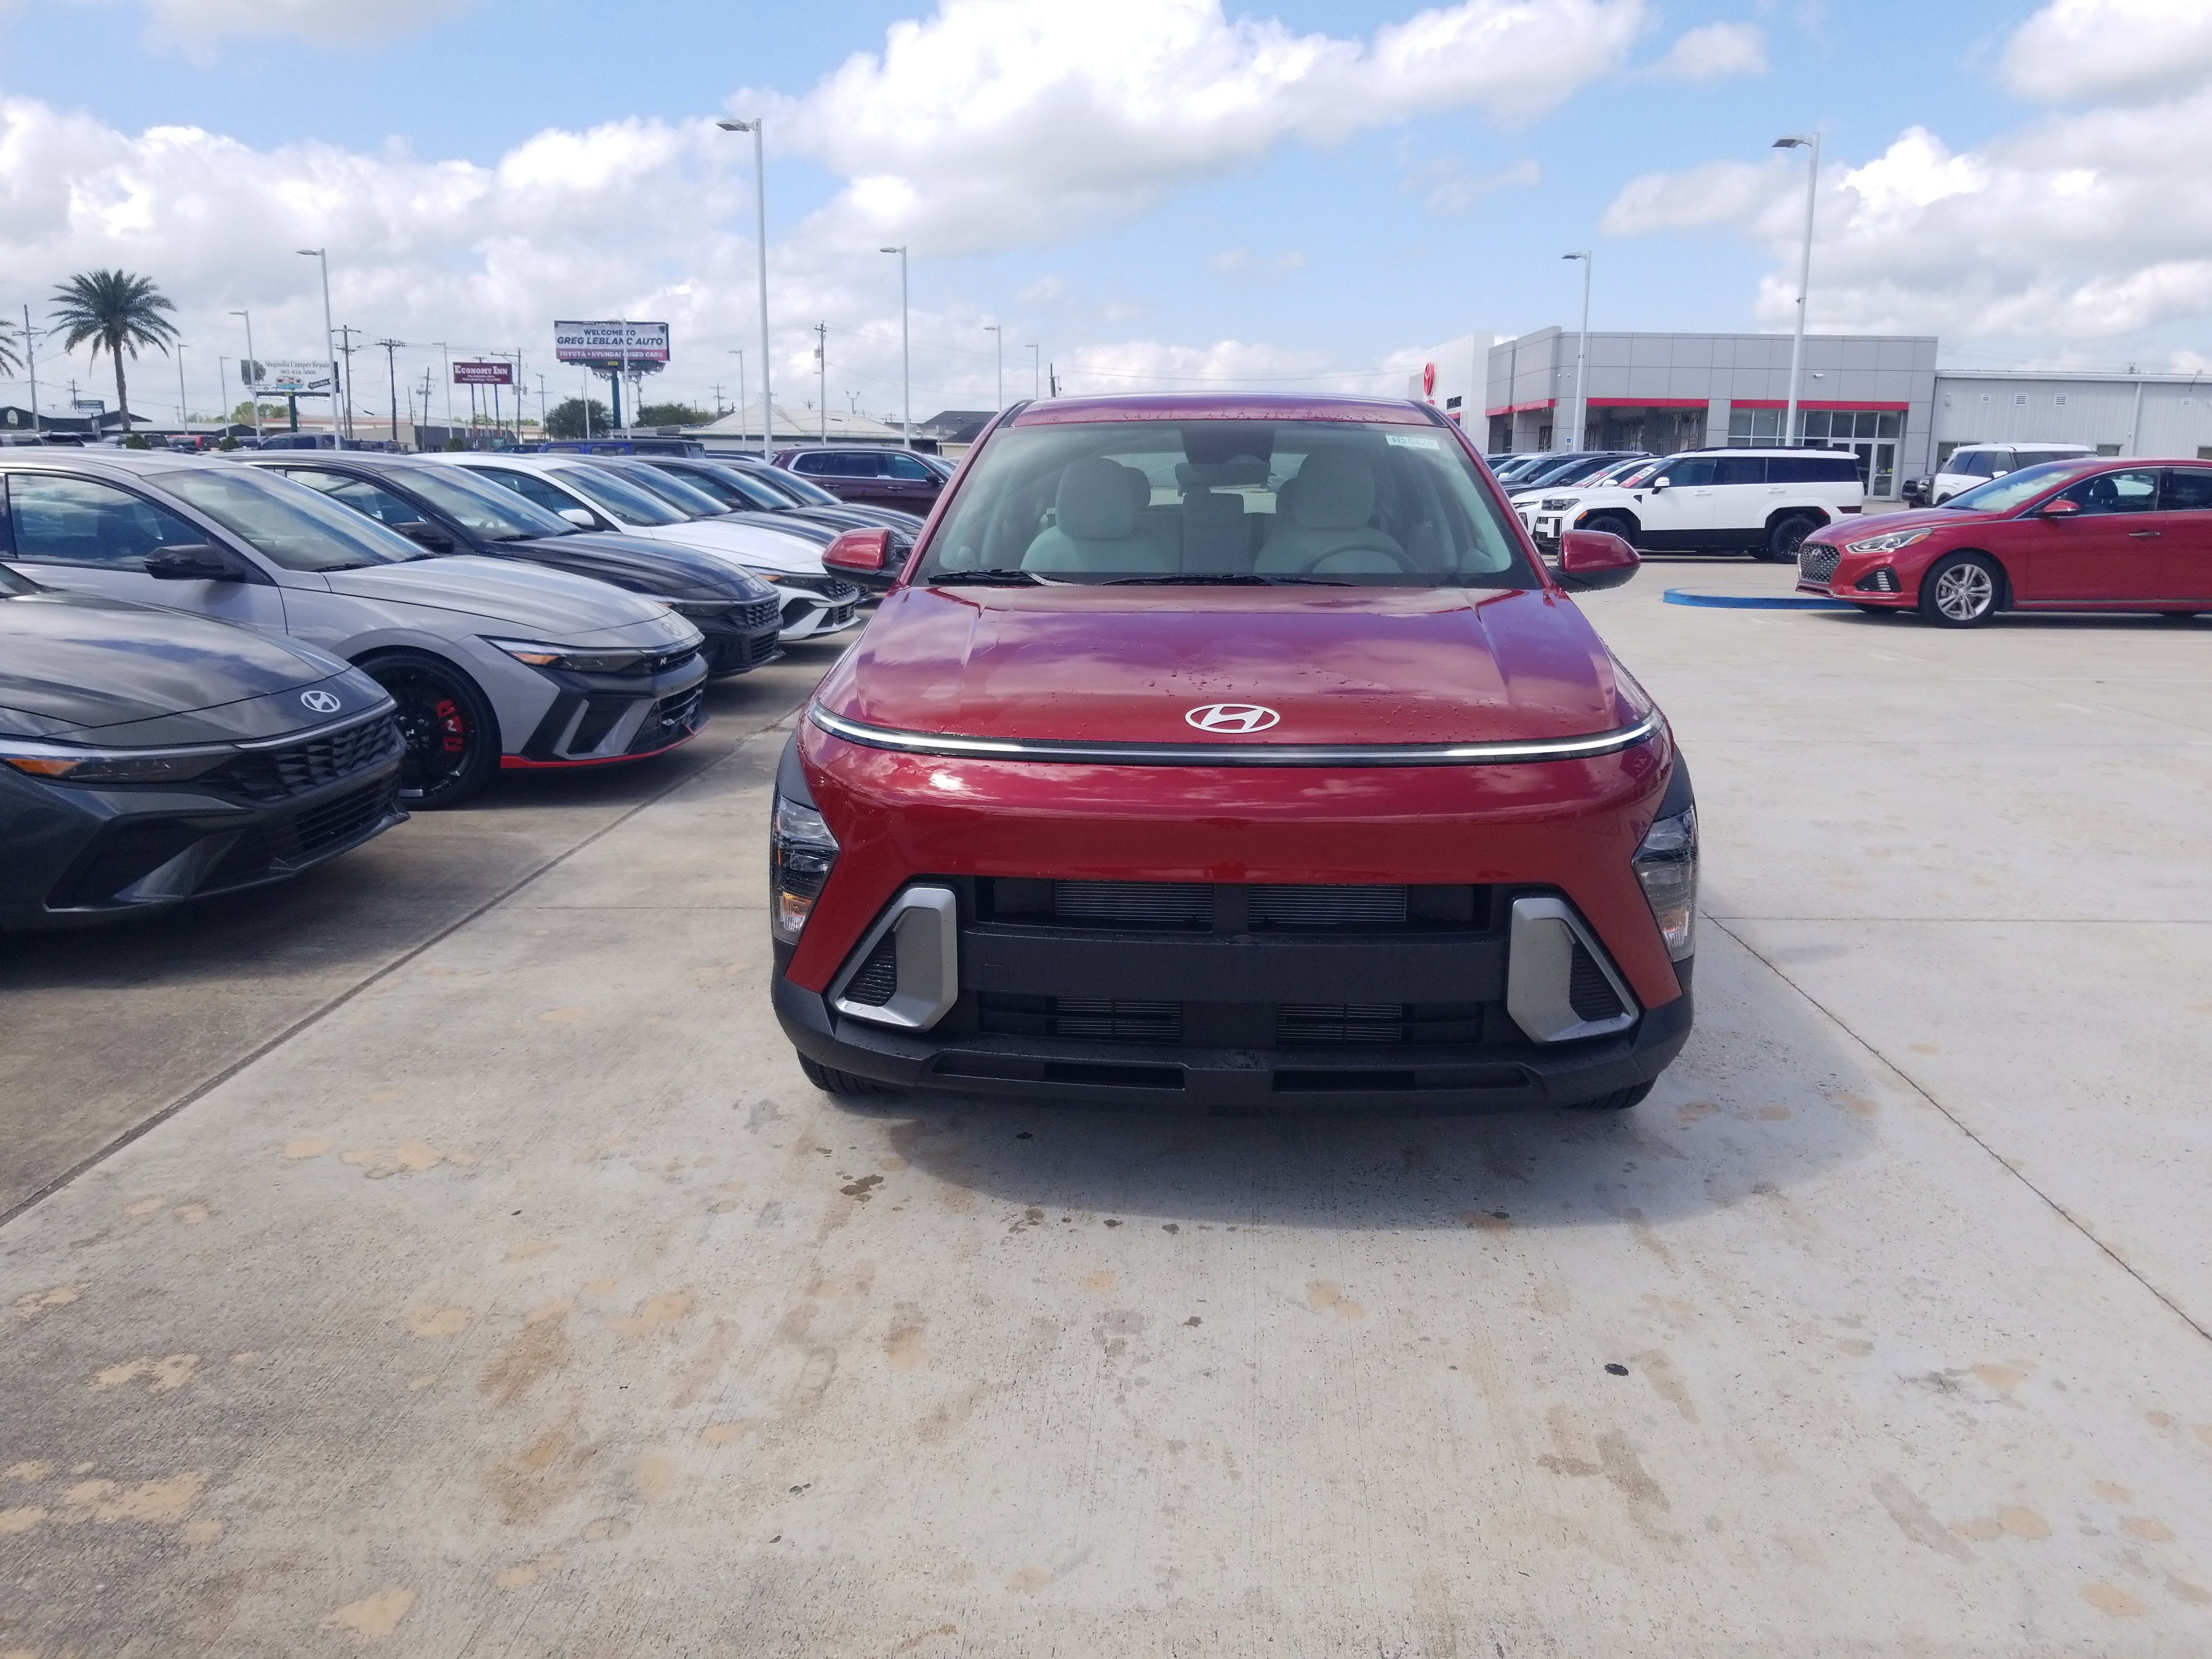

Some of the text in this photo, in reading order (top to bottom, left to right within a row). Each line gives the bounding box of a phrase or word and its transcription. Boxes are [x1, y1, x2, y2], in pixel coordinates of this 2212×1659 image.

[557, 336, 663, 346] GREG LEBLANC AUTO
[290, 361, 312, 369] Camper
